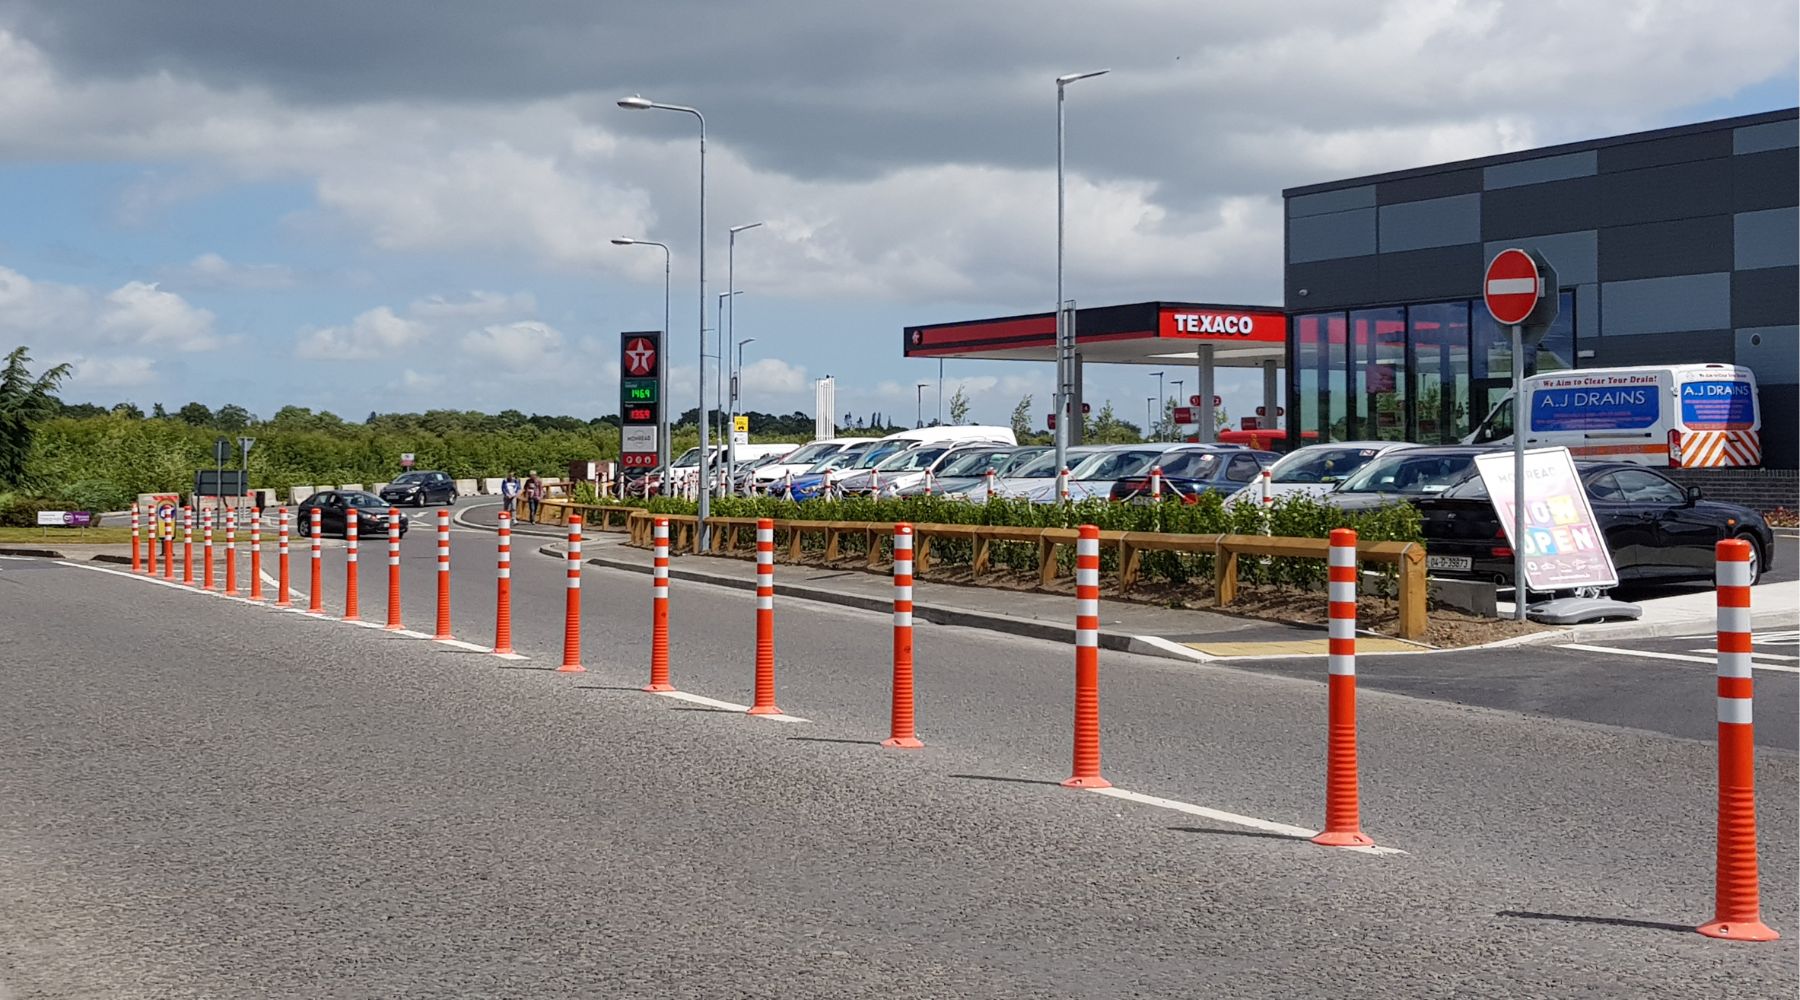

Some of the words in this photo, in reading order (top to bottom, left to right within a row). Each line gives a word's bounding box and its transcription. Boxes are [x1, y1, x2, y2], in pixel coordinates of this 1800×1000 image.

[1173, 313, 1253, 335] TEXACO
[1543, 380, 1554, 388] We
[1556, 379, 1572, 388] Aim
[1573, 378, 1582, 386] to
[1584, 377, 1606, 386] Clear
[1607, 376, 1628, 385] Your
[1630, 375, 1658, 384] Drain!
[1573, 390, 1646, 407] DRAINS
[1707, 385, 1750, 397] DRAINS
